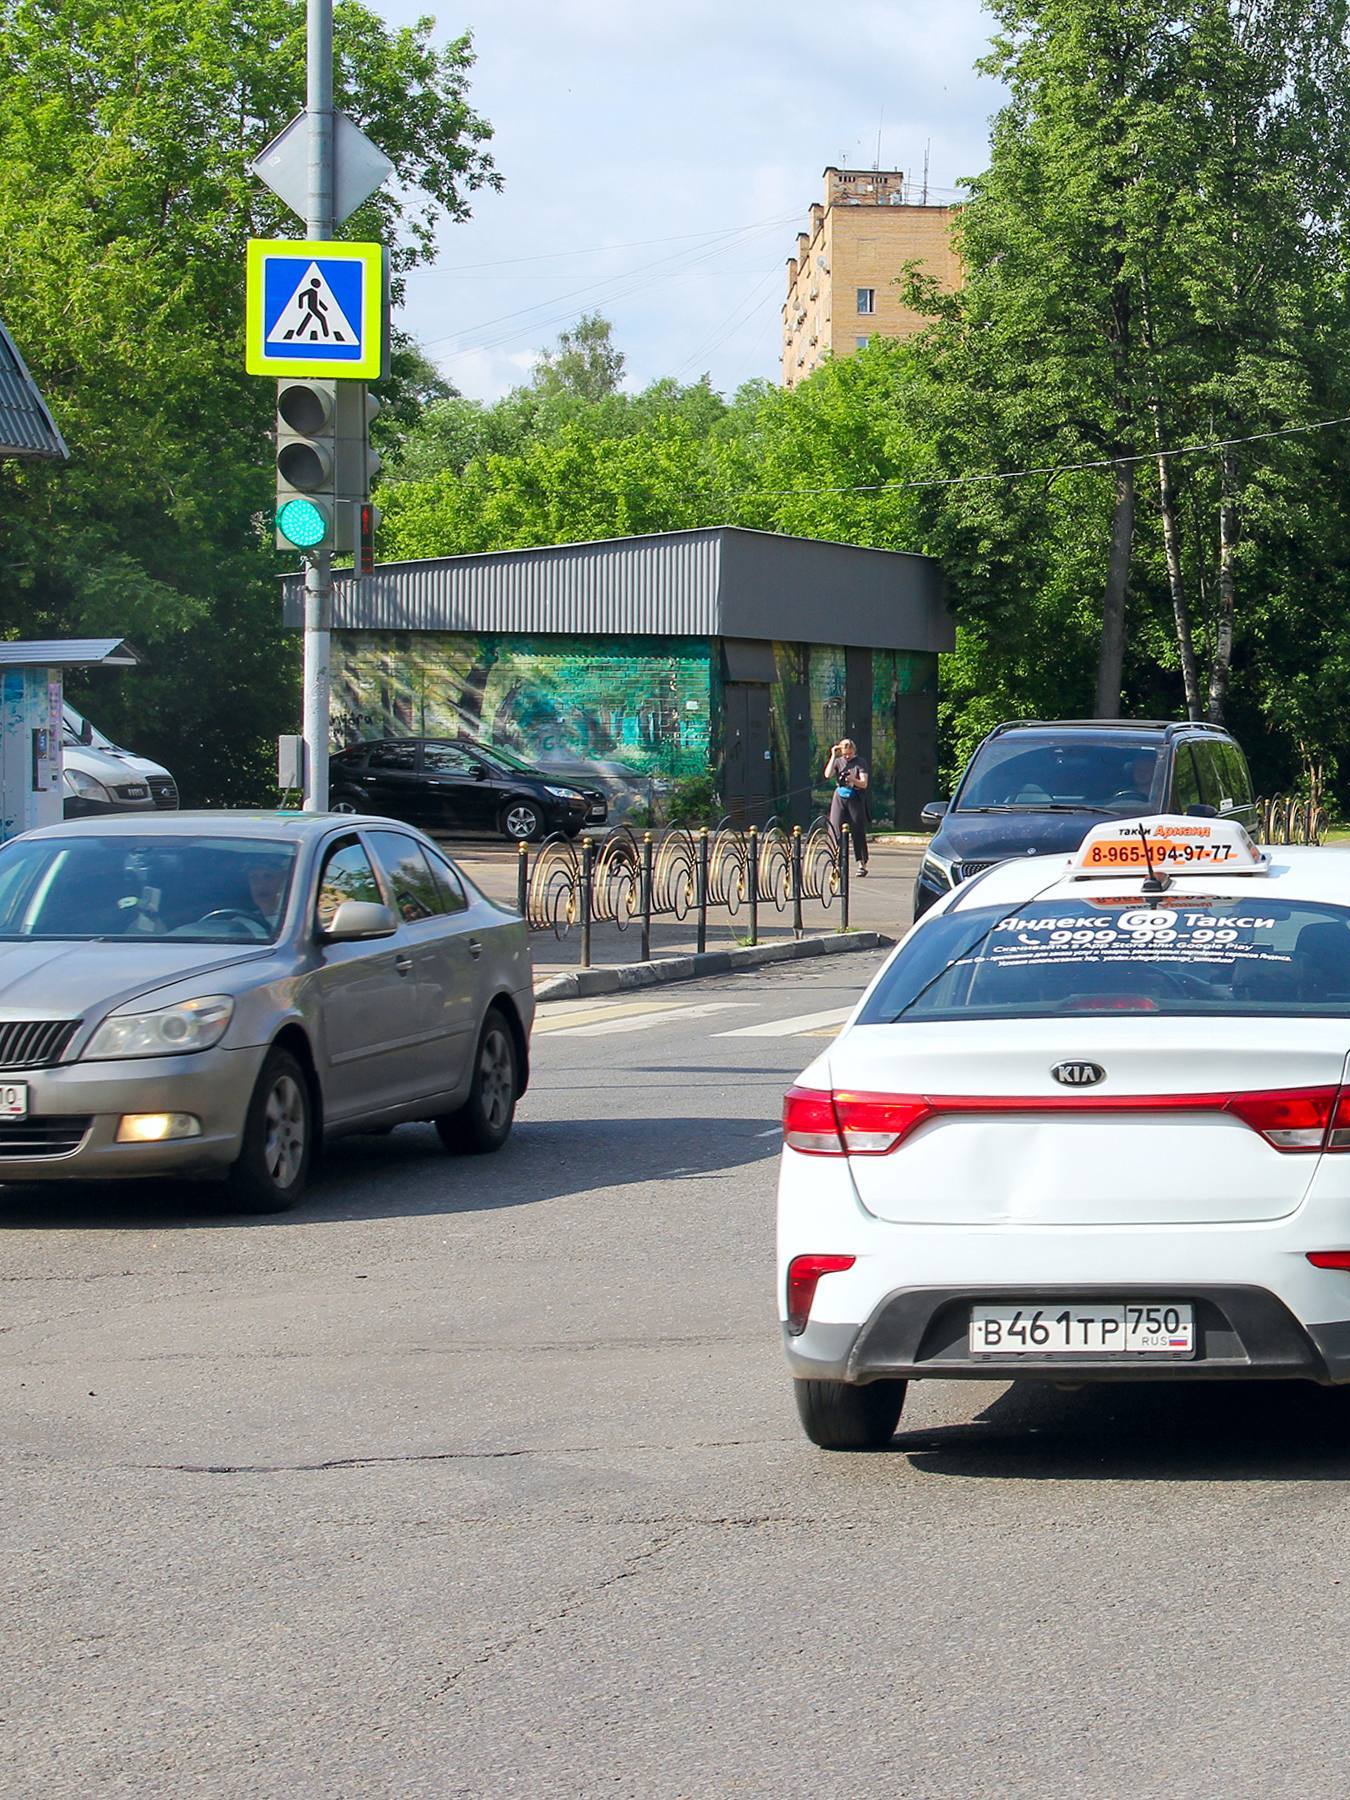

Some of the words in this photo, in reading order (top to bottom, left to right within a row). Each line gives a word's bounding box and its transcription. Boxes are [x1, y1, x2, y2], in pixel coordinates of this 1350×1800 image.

[1153, 826, 1211, 838] Арманд
[1092, 845, 1232, 862] 8-965-194-97-77
[994, 916, 1112, 931] Яндекс
[1127, 914, 1168, 926] Go
[1183, 913, 1276, 929] Такси
[1049, 929, 1239, 945] 999-99-99
[993, 943, 1068, 953] Скачивайте
[1082, 942, 1111, 950] App
[1111, 941, 1145, 949] Store
[1176, 942, 1216, 950] Google
[1224, 942, 1254, 951] Play
[1059, 1066, 1096, 1082] KIA
[984, 1311, 1119, 1346] В461ТР
[1127, 1308, 1180, 1335] 750
[1142, 1336, 1168, 1347] RUS
